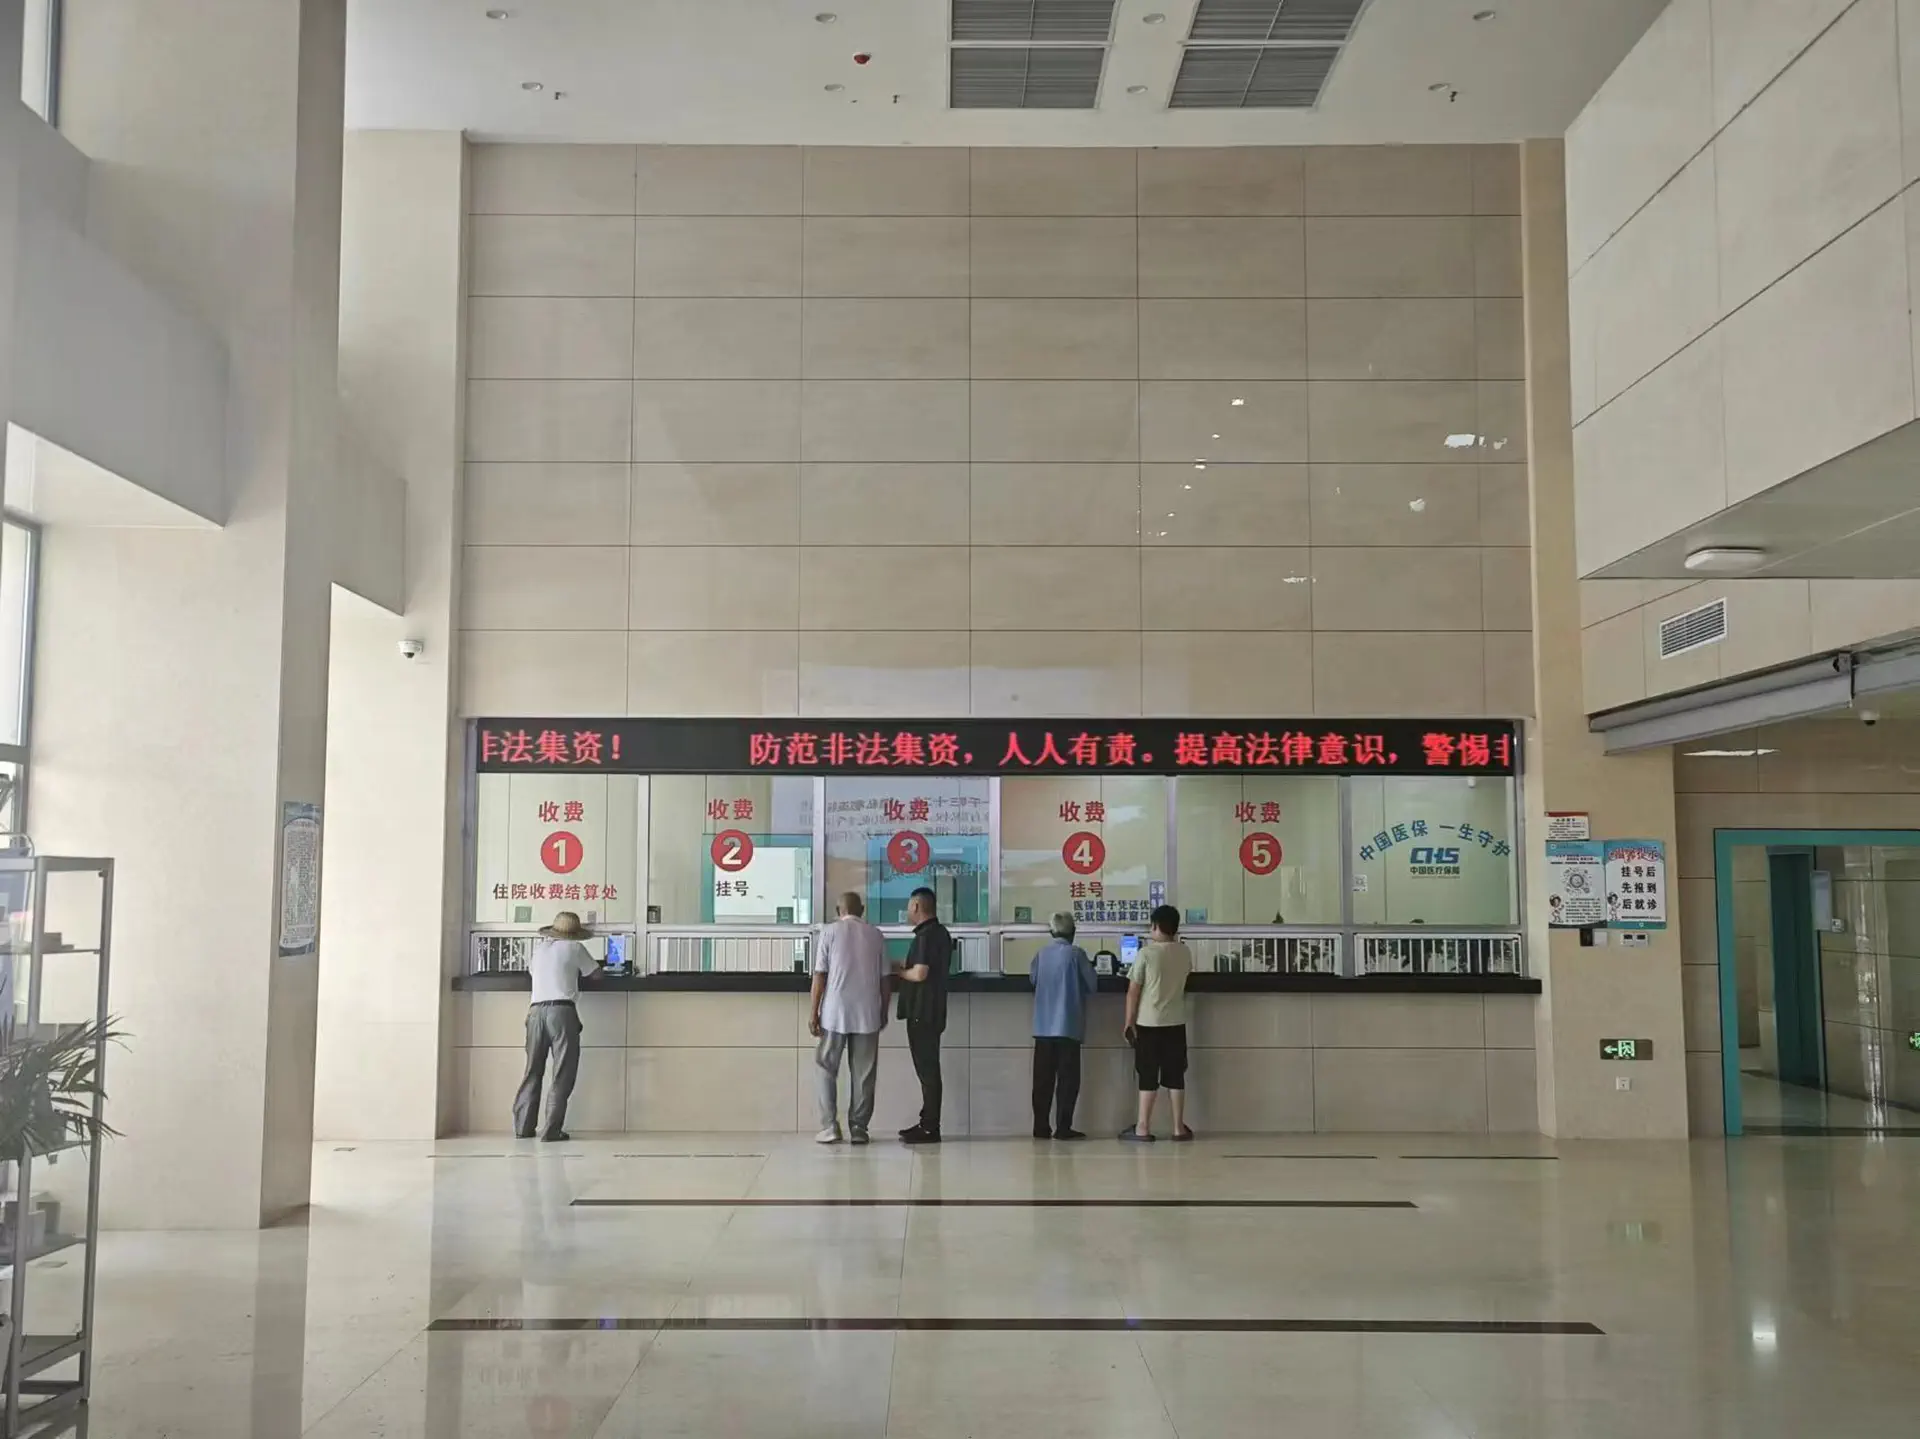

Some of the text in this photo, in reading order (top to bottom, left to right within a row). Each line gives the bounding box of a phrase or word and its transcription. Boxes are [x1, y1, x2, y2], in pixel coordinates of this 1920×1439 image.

[538, 800, 585, 824] 收费
[707, 798, 755, 821] 收费
[883, 799, 930, 823] 收费
[1059, 800, 1106, 823] 收费
[1234, 801, 1281, 824] 收费
[721, 836, 742, 865] 2
[1359, 819, 1429, 862] 中国医保
[1438, 824, 1512, 858] 一生守护
[552, 839, 568, 867] 1
[898, 838, 920, 867] 3
[1071, 840, 1094, 867] 4
[1251, 840, 1272, 868] 5
[1621, 866, 1657, 878] 挂号后
[493, 883, 618, 901] 住院收费结算处
[715, 880, 750, 897] 挂号
[1069, 881, 1103, 898] 挂号
[1621, 882, 1657, 894] 先报到
[1622, 898, 1658, 910] 后就诊
